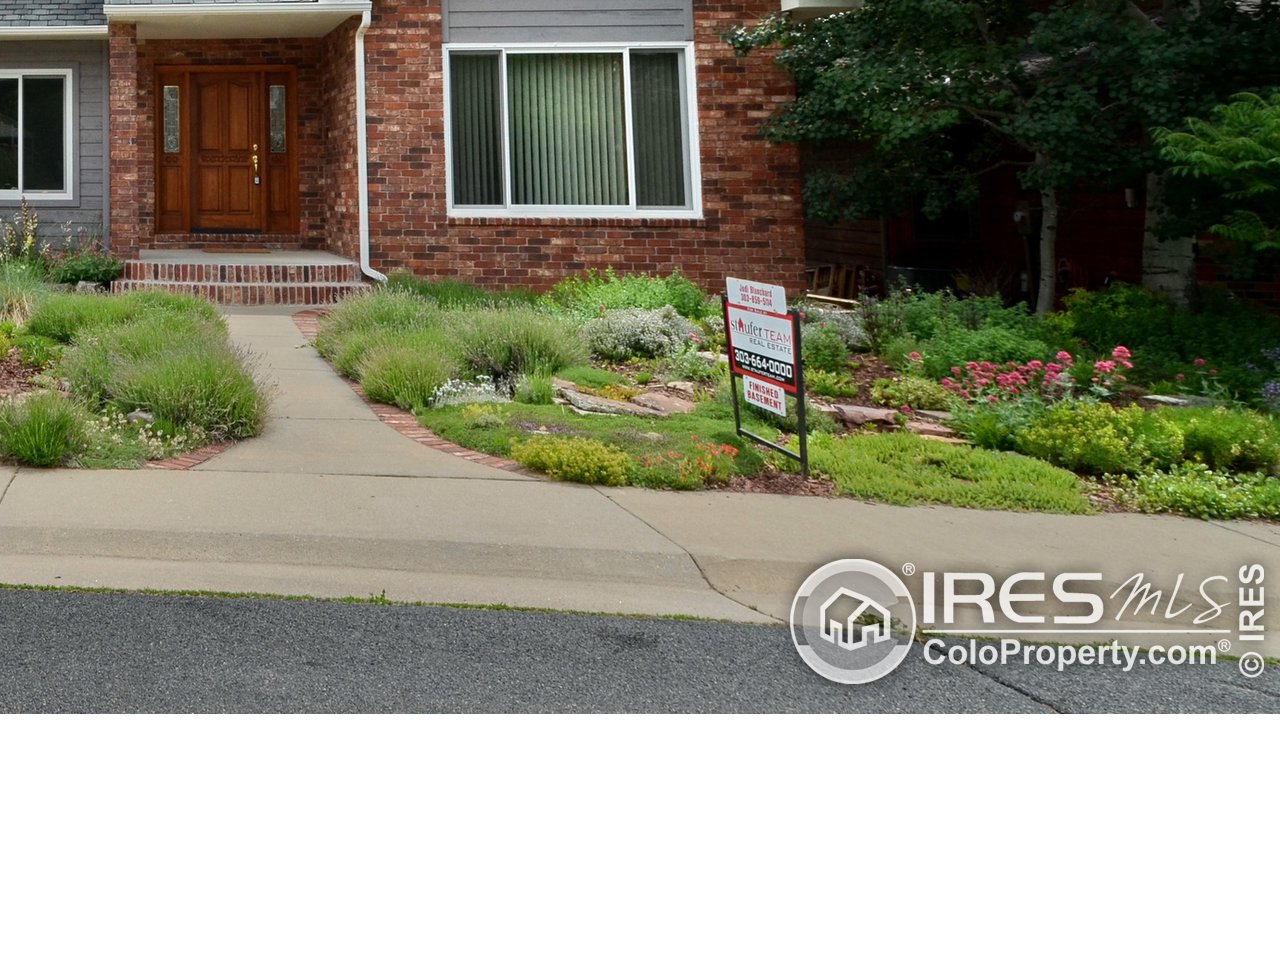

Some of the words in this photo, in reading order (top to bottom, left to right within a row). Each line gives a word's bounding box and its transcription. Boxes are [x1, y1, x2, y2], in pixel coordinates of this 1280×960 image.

[763, 328, 791, 344] TEAM
[749, 337, 766, 348] REAL
[766, 342, 792, 355] ESTATE
[734, 349, 793, 378] 303-664-0000
[748, 381, 779, 399] FINISHED
[747, 390, 782, 410] BASEMENT
